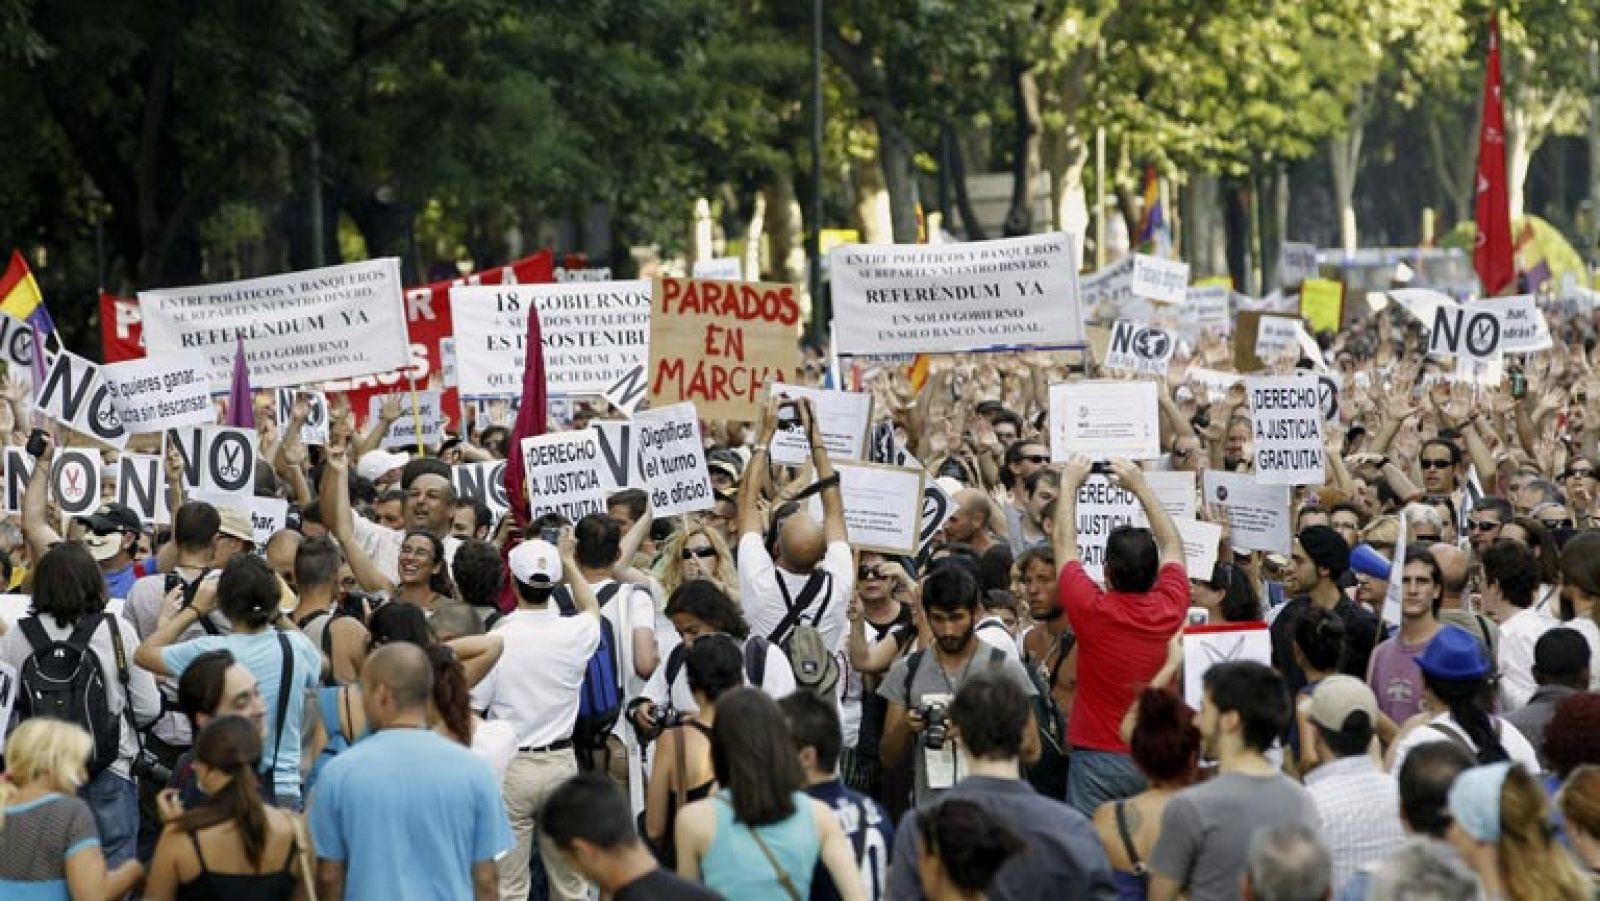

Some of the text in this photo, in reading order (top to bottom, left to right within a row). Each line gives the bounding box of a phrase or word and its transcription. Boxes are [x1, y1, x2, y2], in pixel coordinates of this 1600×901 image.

[845, 254, 886, 265] ENTRE
[981, 244, 1060, 260] BANQUEROS
[160, 295, 206, 310] ENTRE
[300, 271, 385, 293] BANQUEROS
[496, 291, 520, 312] 18
[662, 278, 799, 326] PARADOS
[866, 281, 1045, 303] REFERÉNDUM YA
[181, 308, 370, 348] REFERÉNDUM YA
[953, 309, 1024, 322] GOBIERNO
[487, 334, 511, 351] ES
[703, 323, 745, 362] EN
[1431, 305, 1500, 358] NO
[121, 375, 161, 401] quieres
[141, 402, 157, 421] sin
[1256, 418, 1320, 440] A JUSTICIA
[163, 427, 251, 492] NO
[646, 453, 697, 478] el turno
[1259, 450, 1323, 470] GRATUITA!
[532, 468, 601, 497] A JUSTICIA
[651, 477, 709, 508] de oficio!
